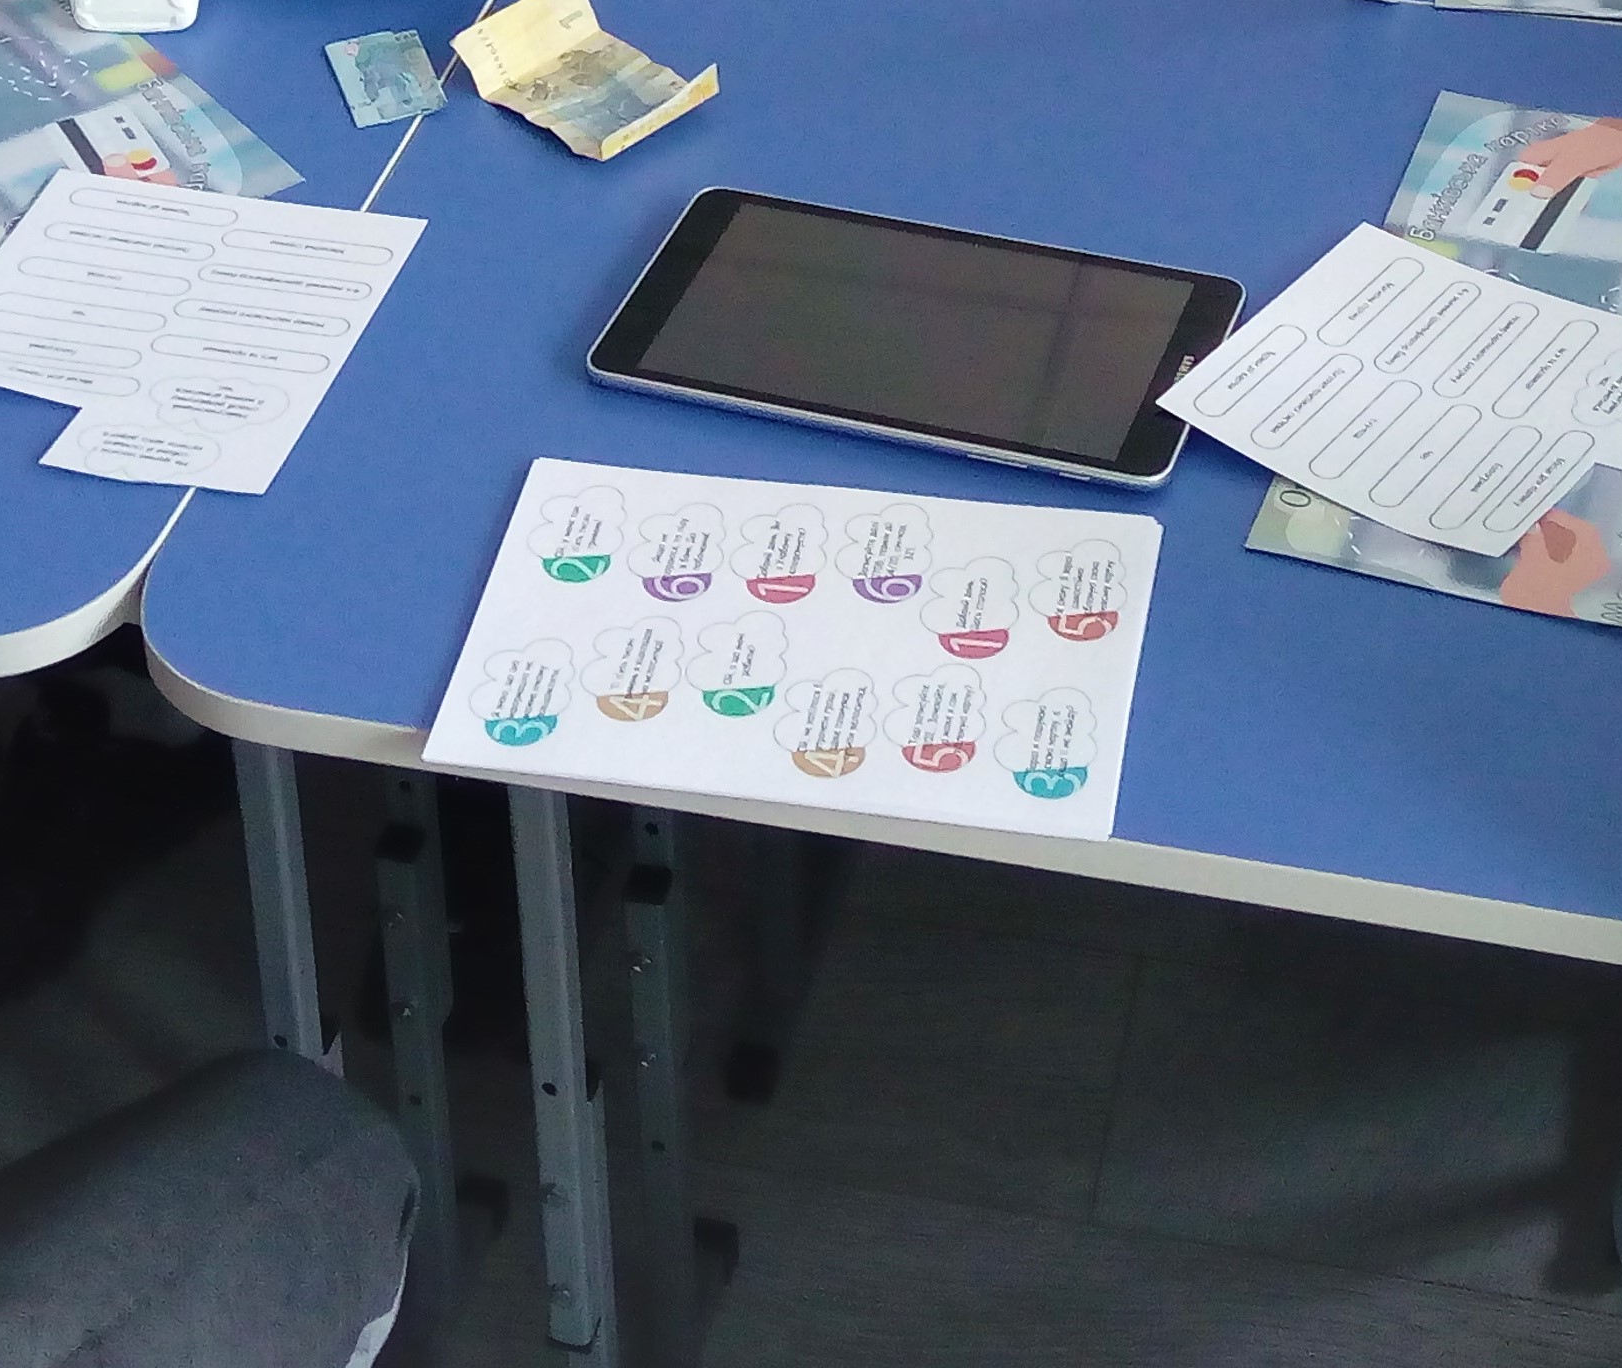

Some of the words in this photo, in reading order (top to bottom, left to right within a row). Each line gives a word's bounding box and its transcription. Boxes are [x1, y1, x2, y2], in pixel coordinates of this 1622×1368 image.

[1408, 151, 1487, 242] Банківська
[546, 557, 602, 580] 2
[651, 574, 705, 602] 6
[754, 578, 812, 599] 1
[860, 578, 918, 602] 6
[1056, 612, 1117, 638] 5
[948, 632, 1004, 655] 1
[613, 692, 660, 722] 4
[711, 691, 768, 717] 2
[489, 718, 551, 745] 3
[913, 741, 972, 770] 5
[1022, 770, 1084, 797] 3
